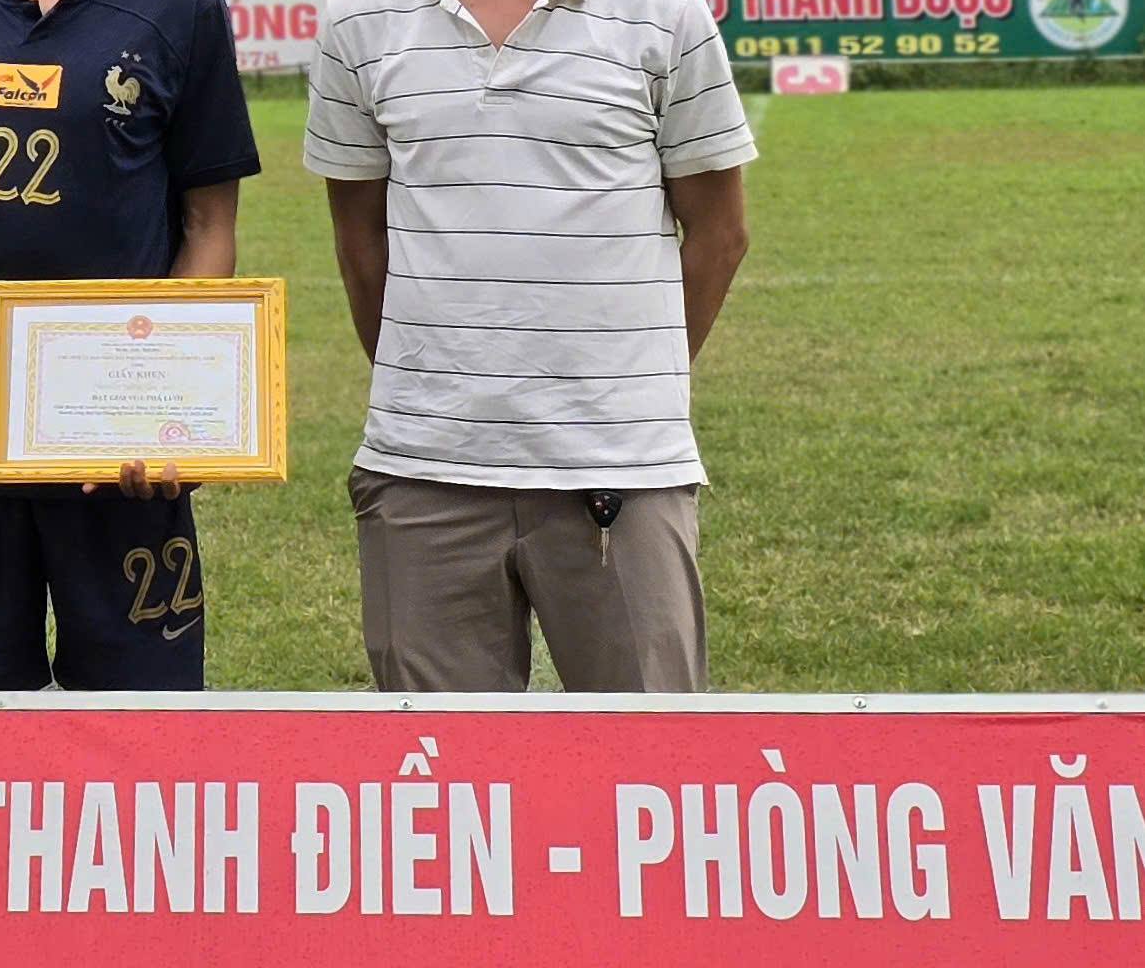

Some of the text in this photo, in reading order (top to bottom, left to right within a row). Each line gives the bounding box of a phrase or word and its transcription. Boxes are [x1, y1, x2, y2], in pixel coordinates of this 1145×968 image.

[735, 33, 1000, 56] 0911 52 90 52
[123, 536, 204, 624] 22
[291, 736, 514, 916] ĐIỀN
[549, 847, 582, 873] -
[615, 749, 951, 921] PHÒNG
